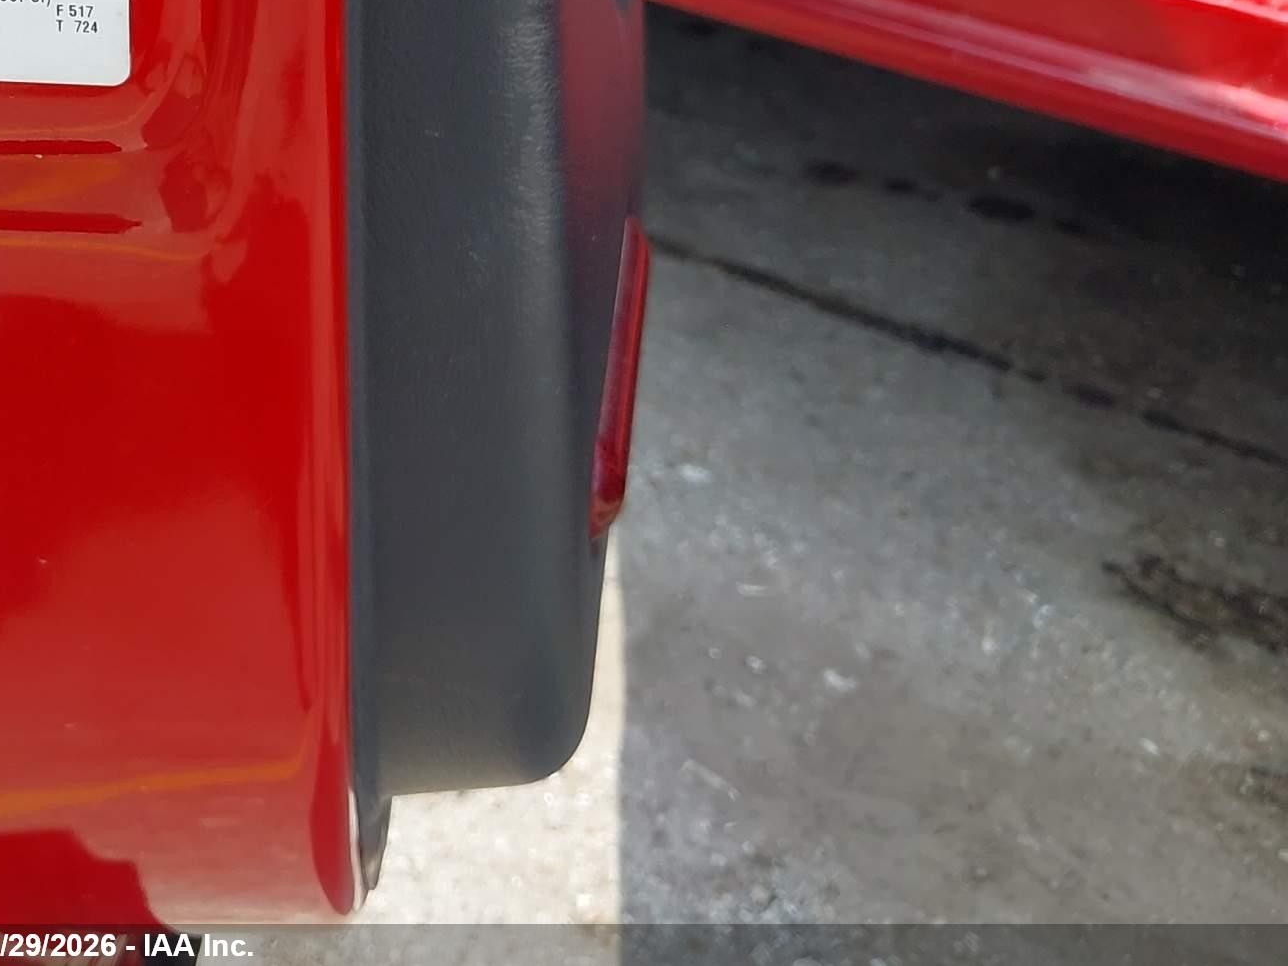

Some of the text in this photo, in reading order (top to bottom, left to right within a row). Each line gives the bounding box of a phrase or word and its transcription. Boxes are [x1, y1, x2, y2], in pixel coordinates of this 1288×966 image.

[56, 4, 94, 18] F 517
[56, 20, 98, 34] T 724
